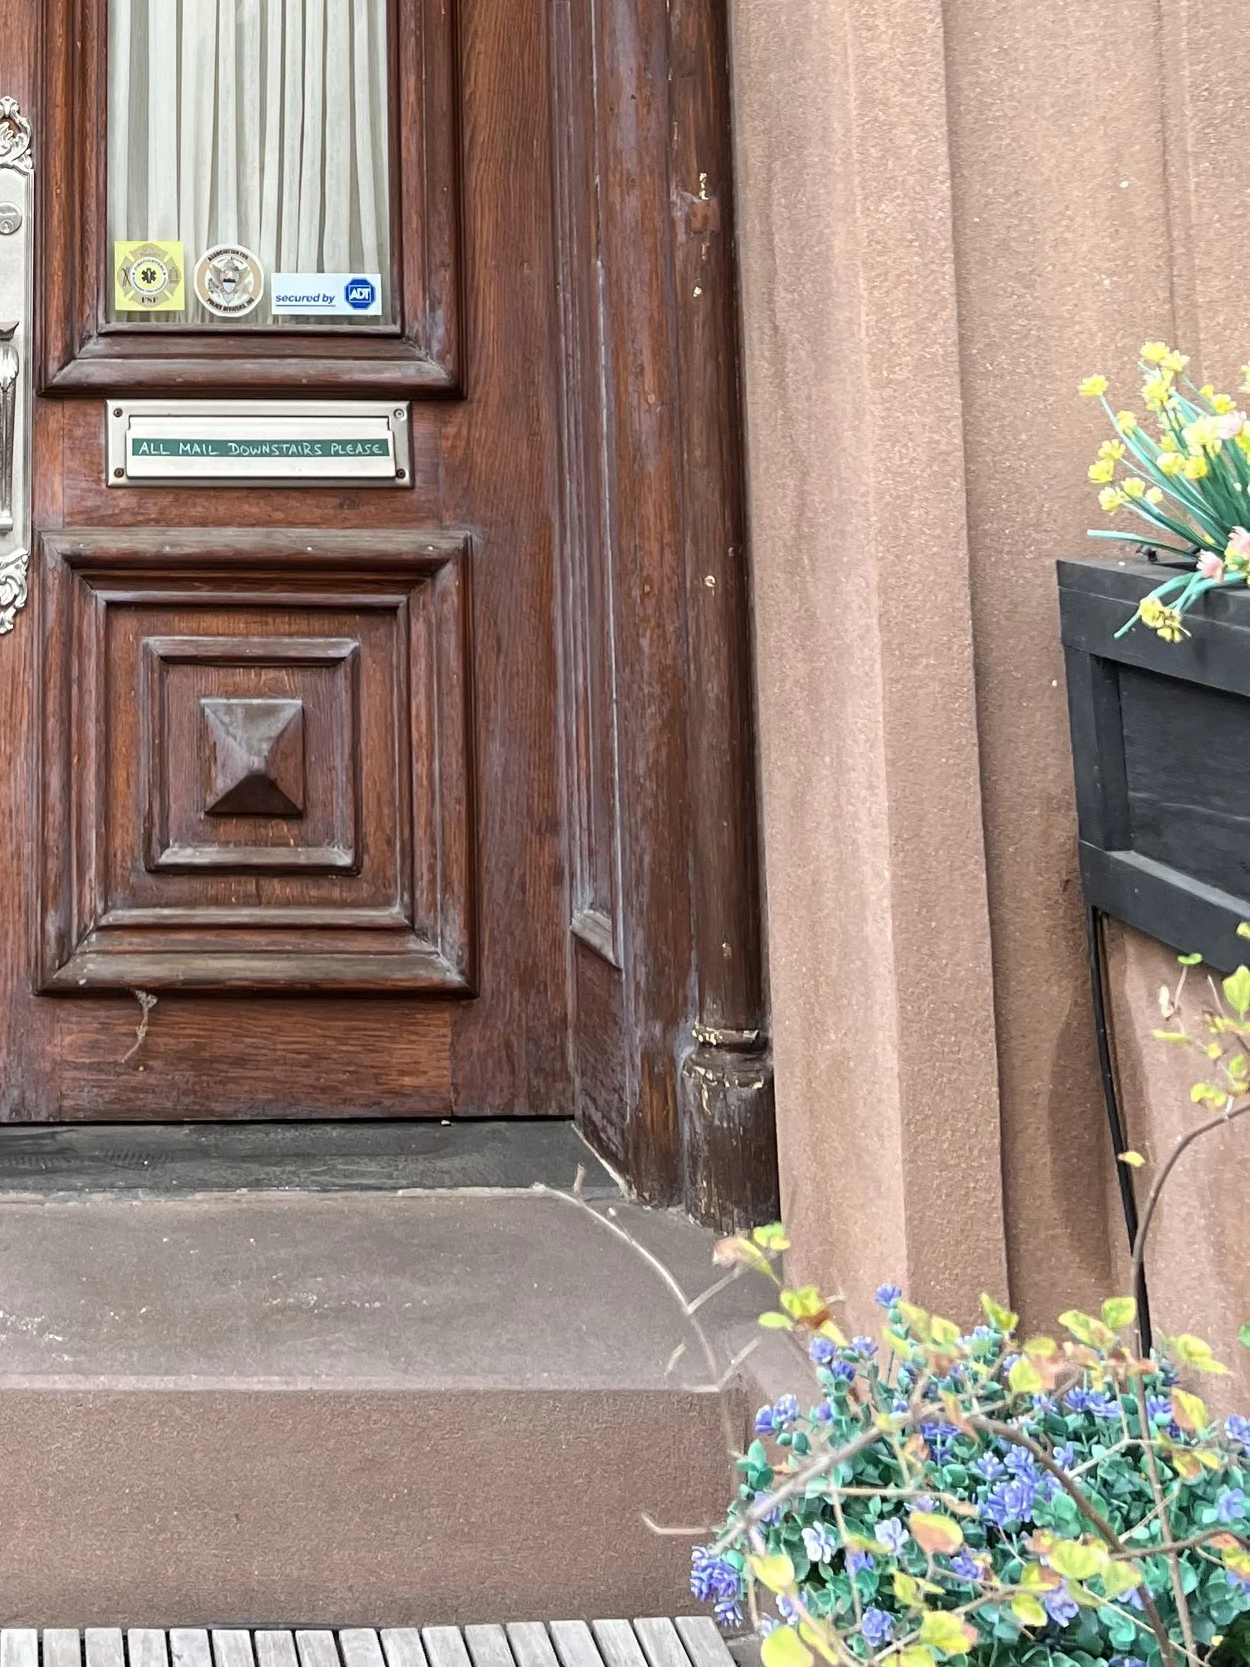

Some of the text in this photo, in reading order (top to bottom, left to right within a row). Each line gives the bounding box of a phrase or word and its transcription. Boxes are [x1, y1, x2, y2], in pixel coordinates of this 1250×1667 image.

[275, 287, 370, 304] secured by ADT
[138, 441, 383, 456] ALL MAIL DOWNSTAIRS PLEASE
